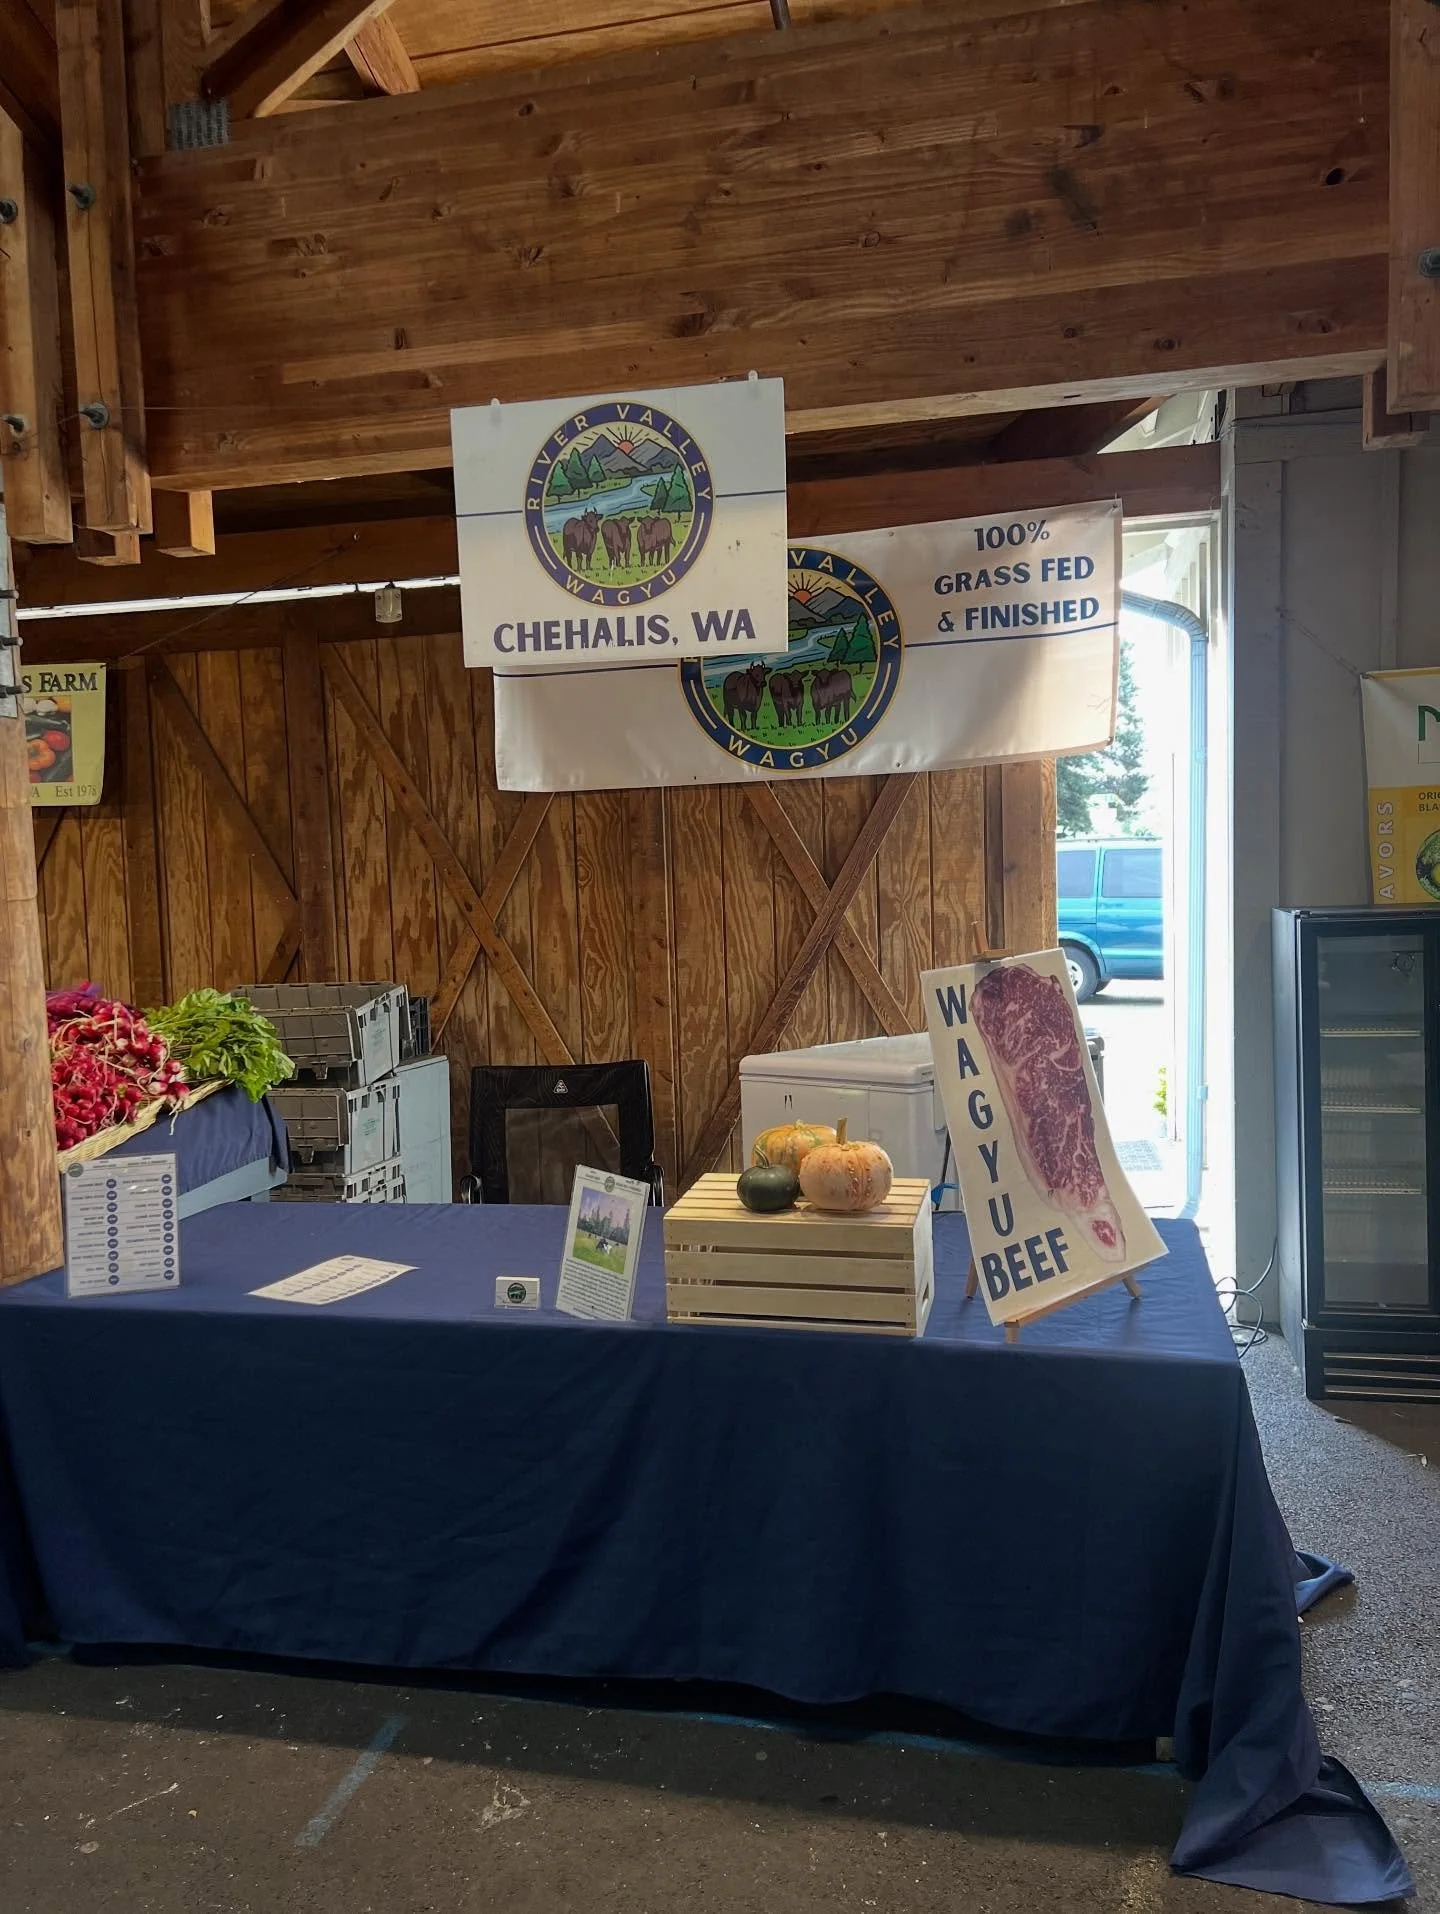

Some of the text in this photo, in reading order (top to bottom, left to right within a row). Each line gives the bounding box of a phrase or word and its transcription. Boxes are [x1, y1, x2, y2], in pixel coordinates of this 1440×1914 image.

[527, 404, 711, 511] RIVER VALLEY
[974, 519, 1050, 552] 100%
[564, 569, 677, 605] WAGYU
[934, 556, 1095, 595] GRASS FED
[793, 551, 899, 649] VALLEY
[938, 597, 1099, 632] & FINISHED
[493, 609, 756, 653] CHEHALIS, WA
[39, 672, 98, 693] FARM
[727, 727, 858, 767] WAGYU
[55, 785, 73, 797] Est
[935, 984, 1014, 1237] WAGYU
[980, 1227, 1069, 1302] BEEF
